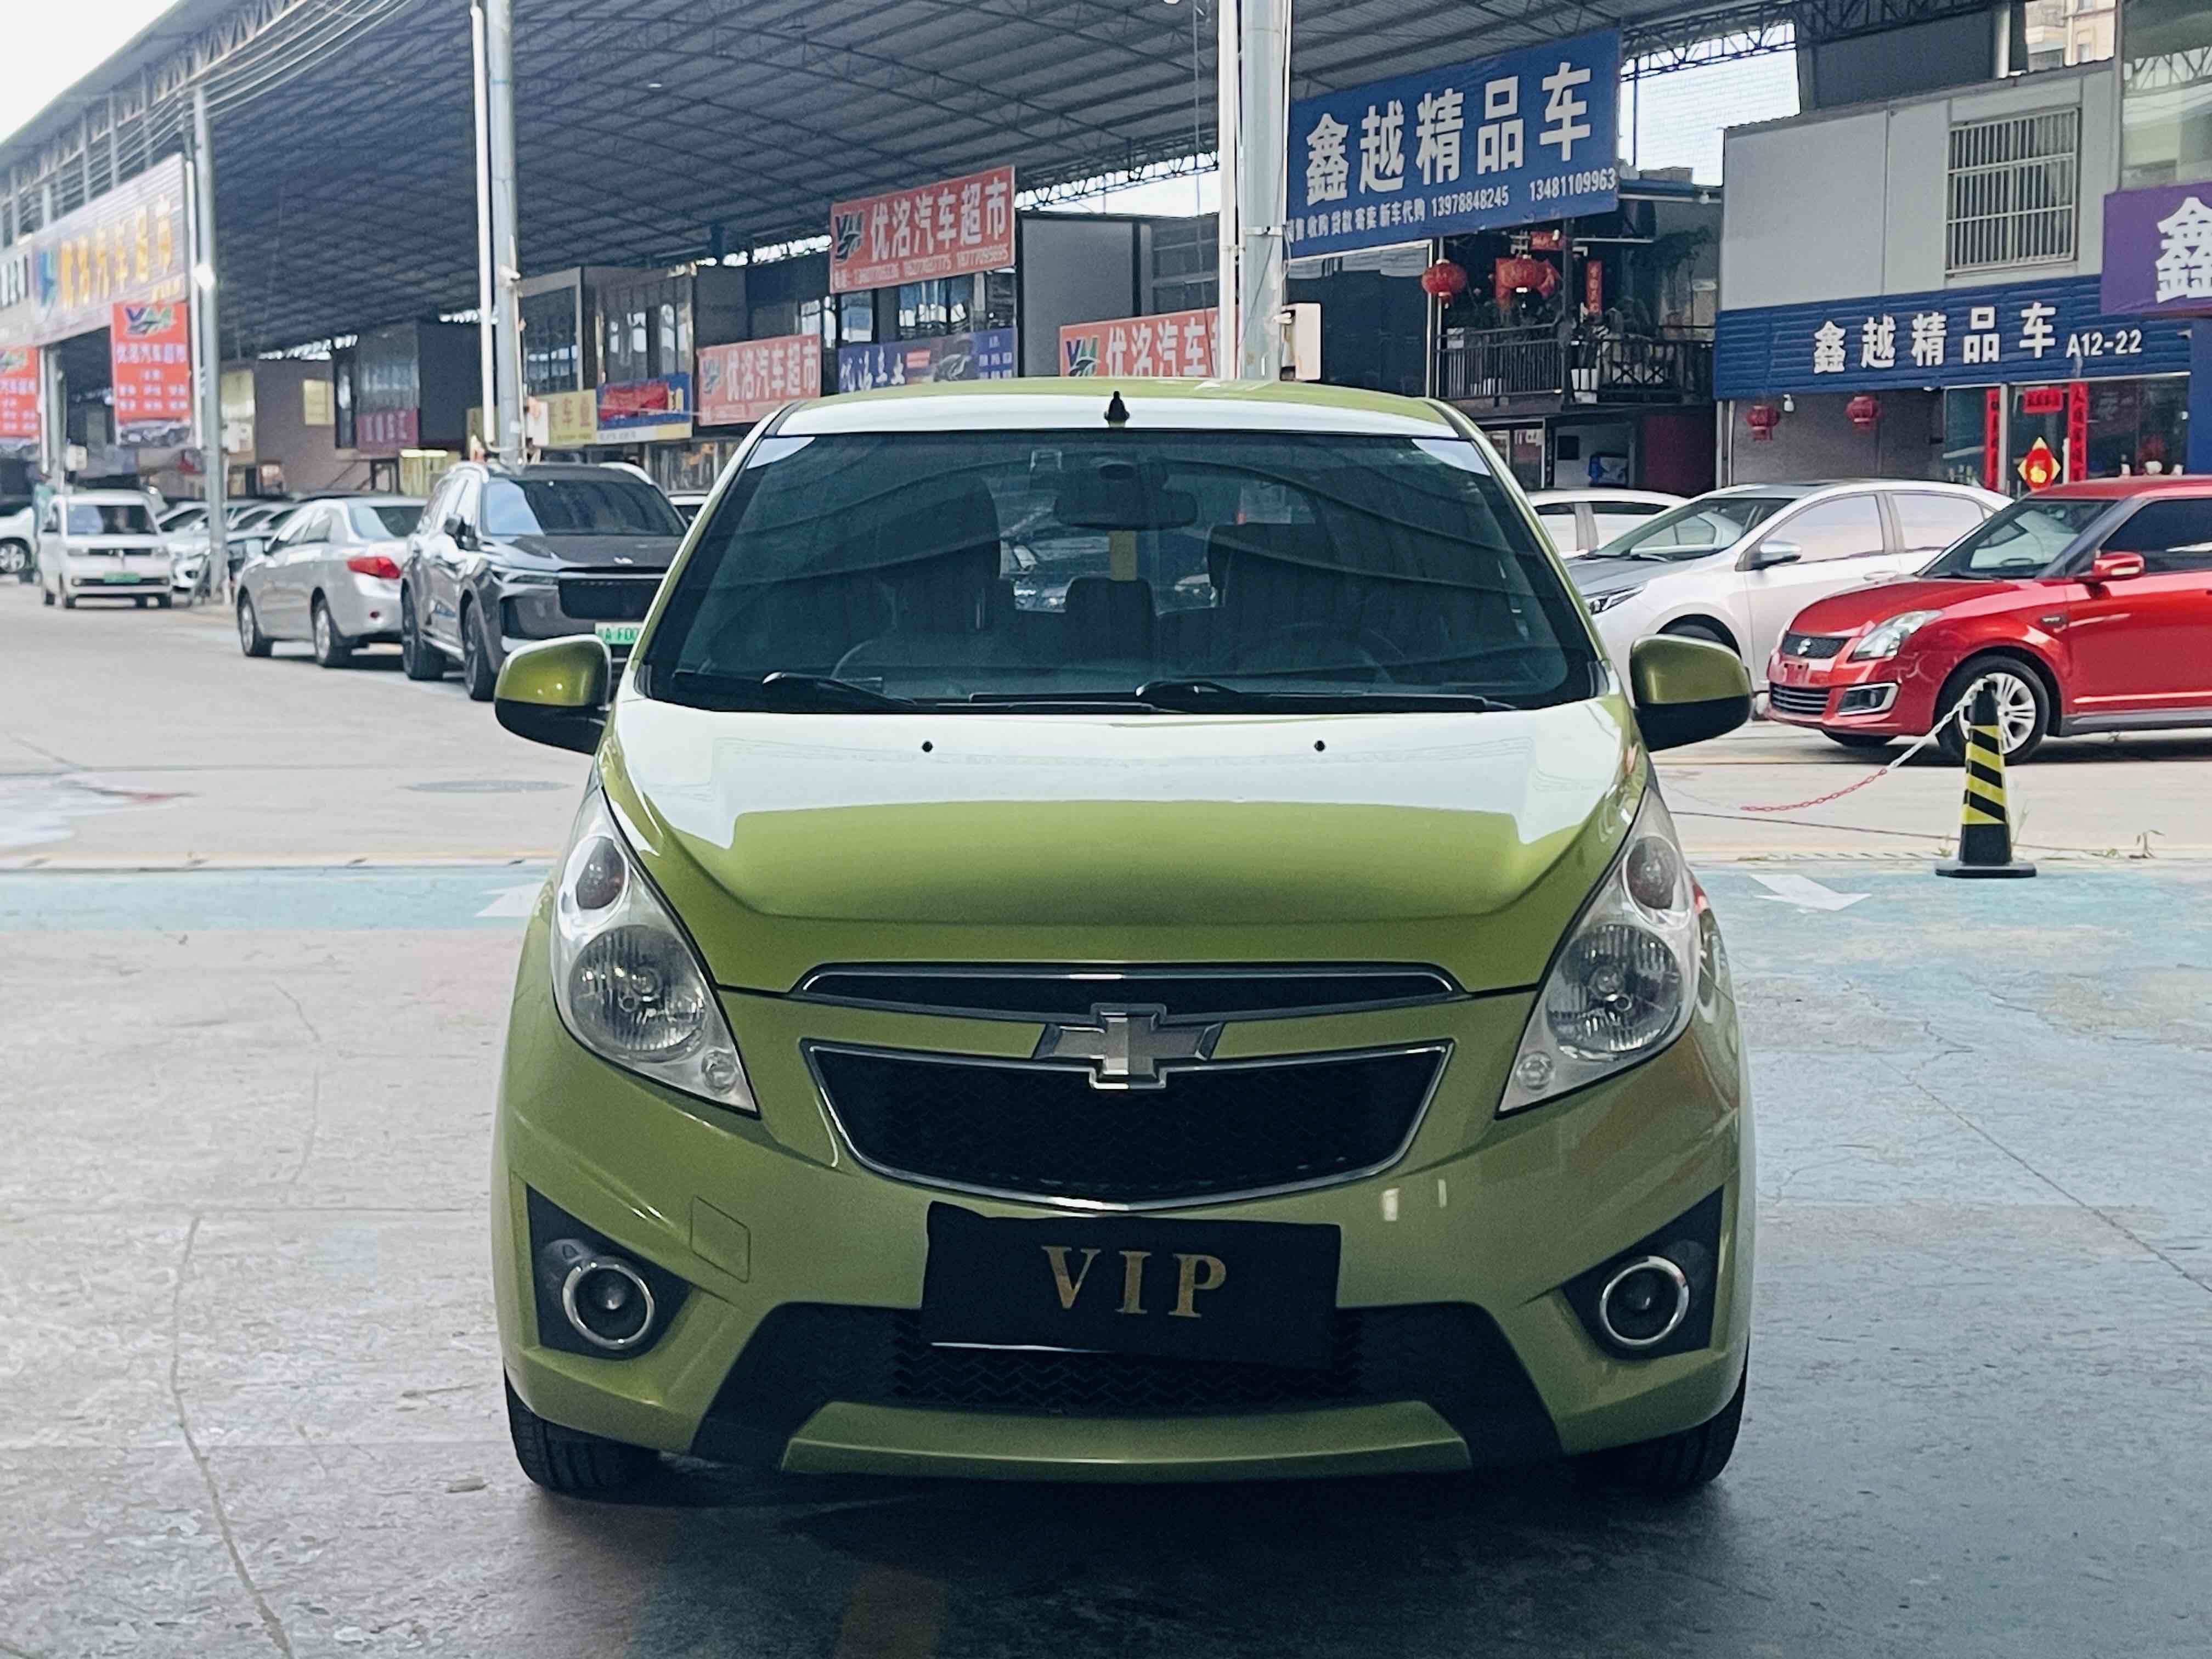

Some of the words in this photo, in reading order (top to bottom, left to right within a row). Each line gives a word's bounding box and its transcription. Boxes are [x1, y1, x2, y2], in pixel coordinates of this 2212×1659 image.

[1306, 62, 1591, 206] 鑫越精品车
[1431, 185, 1509, 217] 13978848245
[1530, 167, 1616, 201] 13481109963
[1814, 302, 2056, 374] 鑫越精品车
[2066, 330, 2142, 358] A12-22
[1042, 1246, 1227, 1318] VIP
